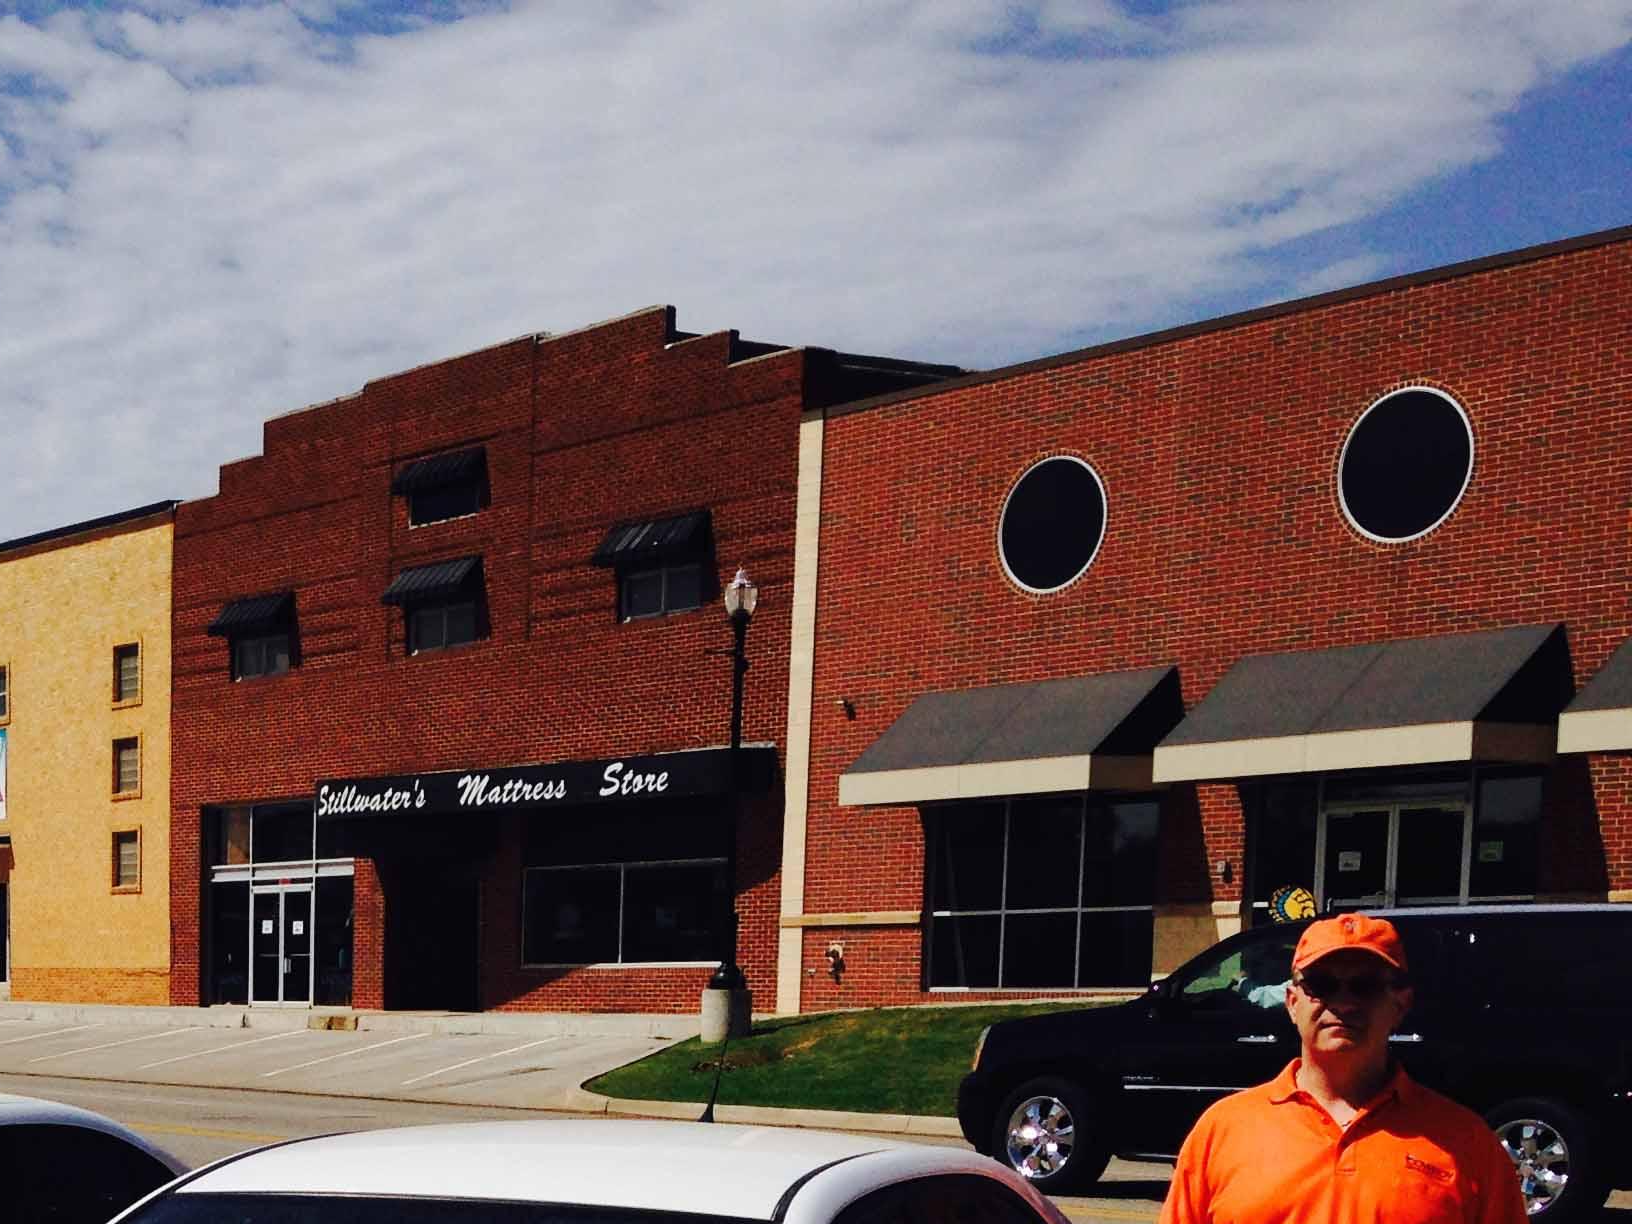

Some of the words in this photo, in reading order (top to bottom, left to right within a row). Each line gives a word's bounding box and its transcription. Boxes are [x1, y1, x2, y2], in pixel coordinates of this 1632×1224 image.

[318, 778, 426, 816] Stillwater's
[457, 774, 568, 807] Mattress
[599, 761, 669, 797] Store
